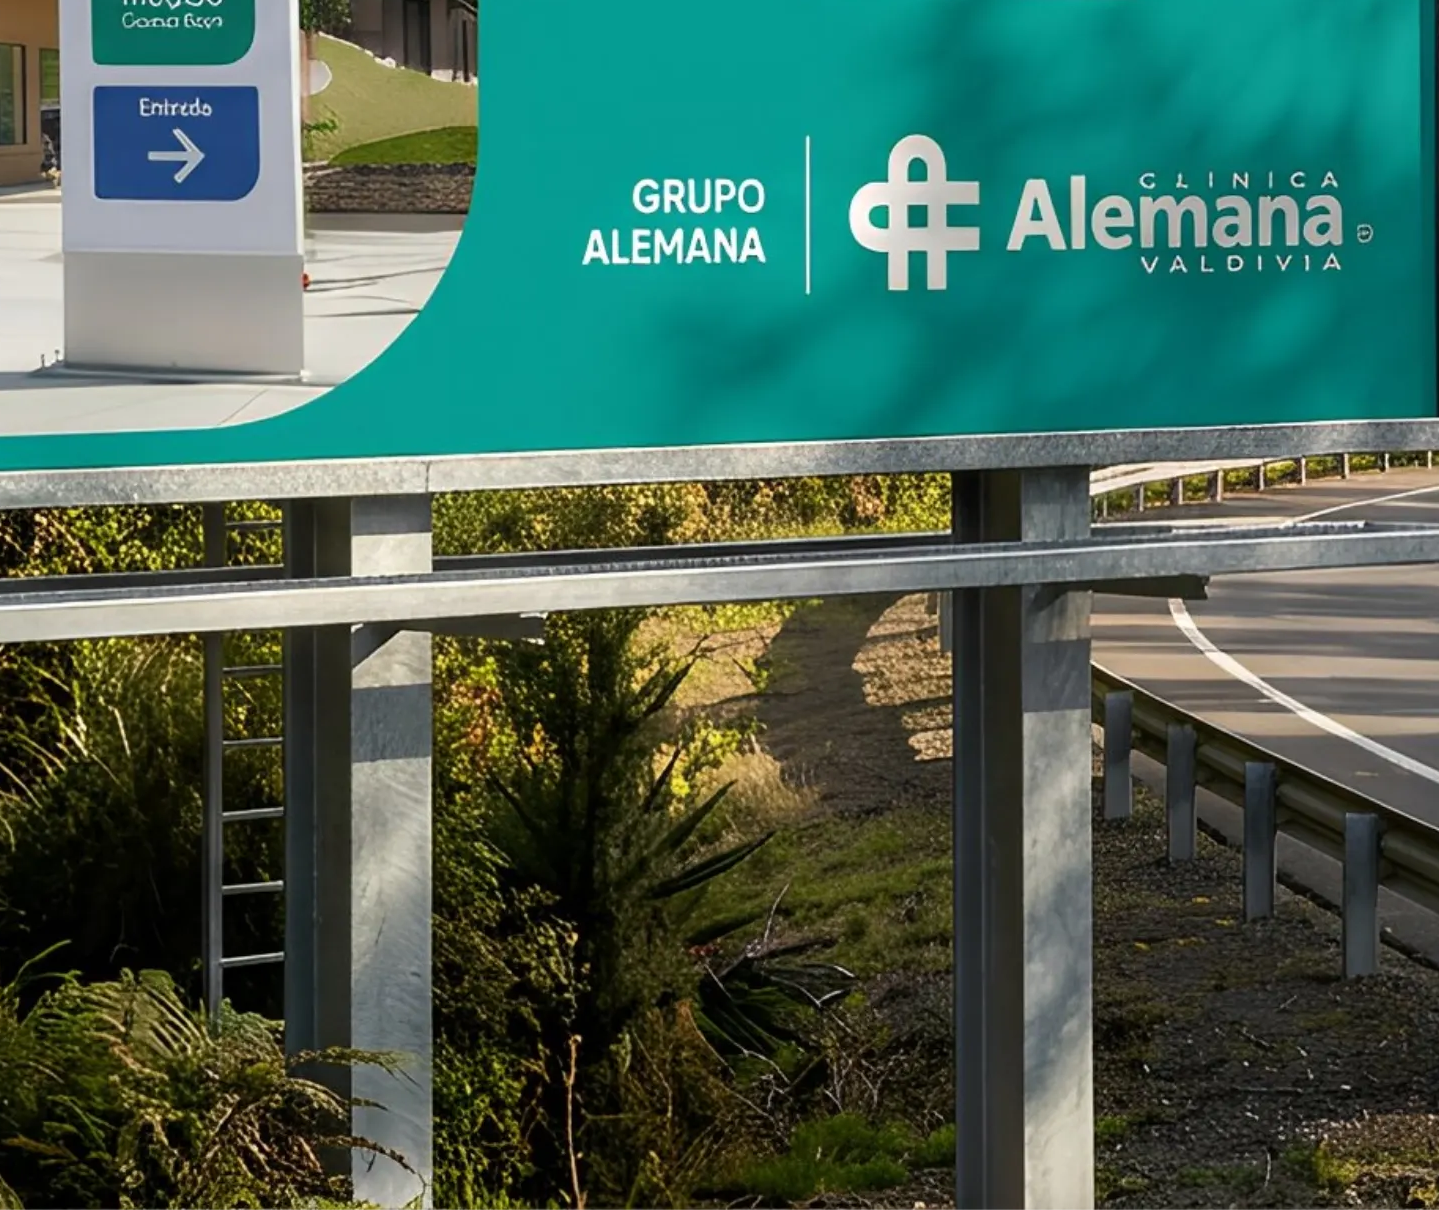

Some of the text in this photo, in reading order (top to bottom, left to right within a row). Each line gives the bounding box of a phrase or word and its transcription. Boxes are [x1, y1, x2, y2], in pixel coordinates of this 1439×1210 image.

[632, 178, 765, 214] GRUPO
[1138, 171, 1339, 189] CLINICA
[1006, 175, 1344, 251] Alemana
[582, 227, 766, 265] ALEMANA
[1140, 253, 1342, 274] VALDIVIA
